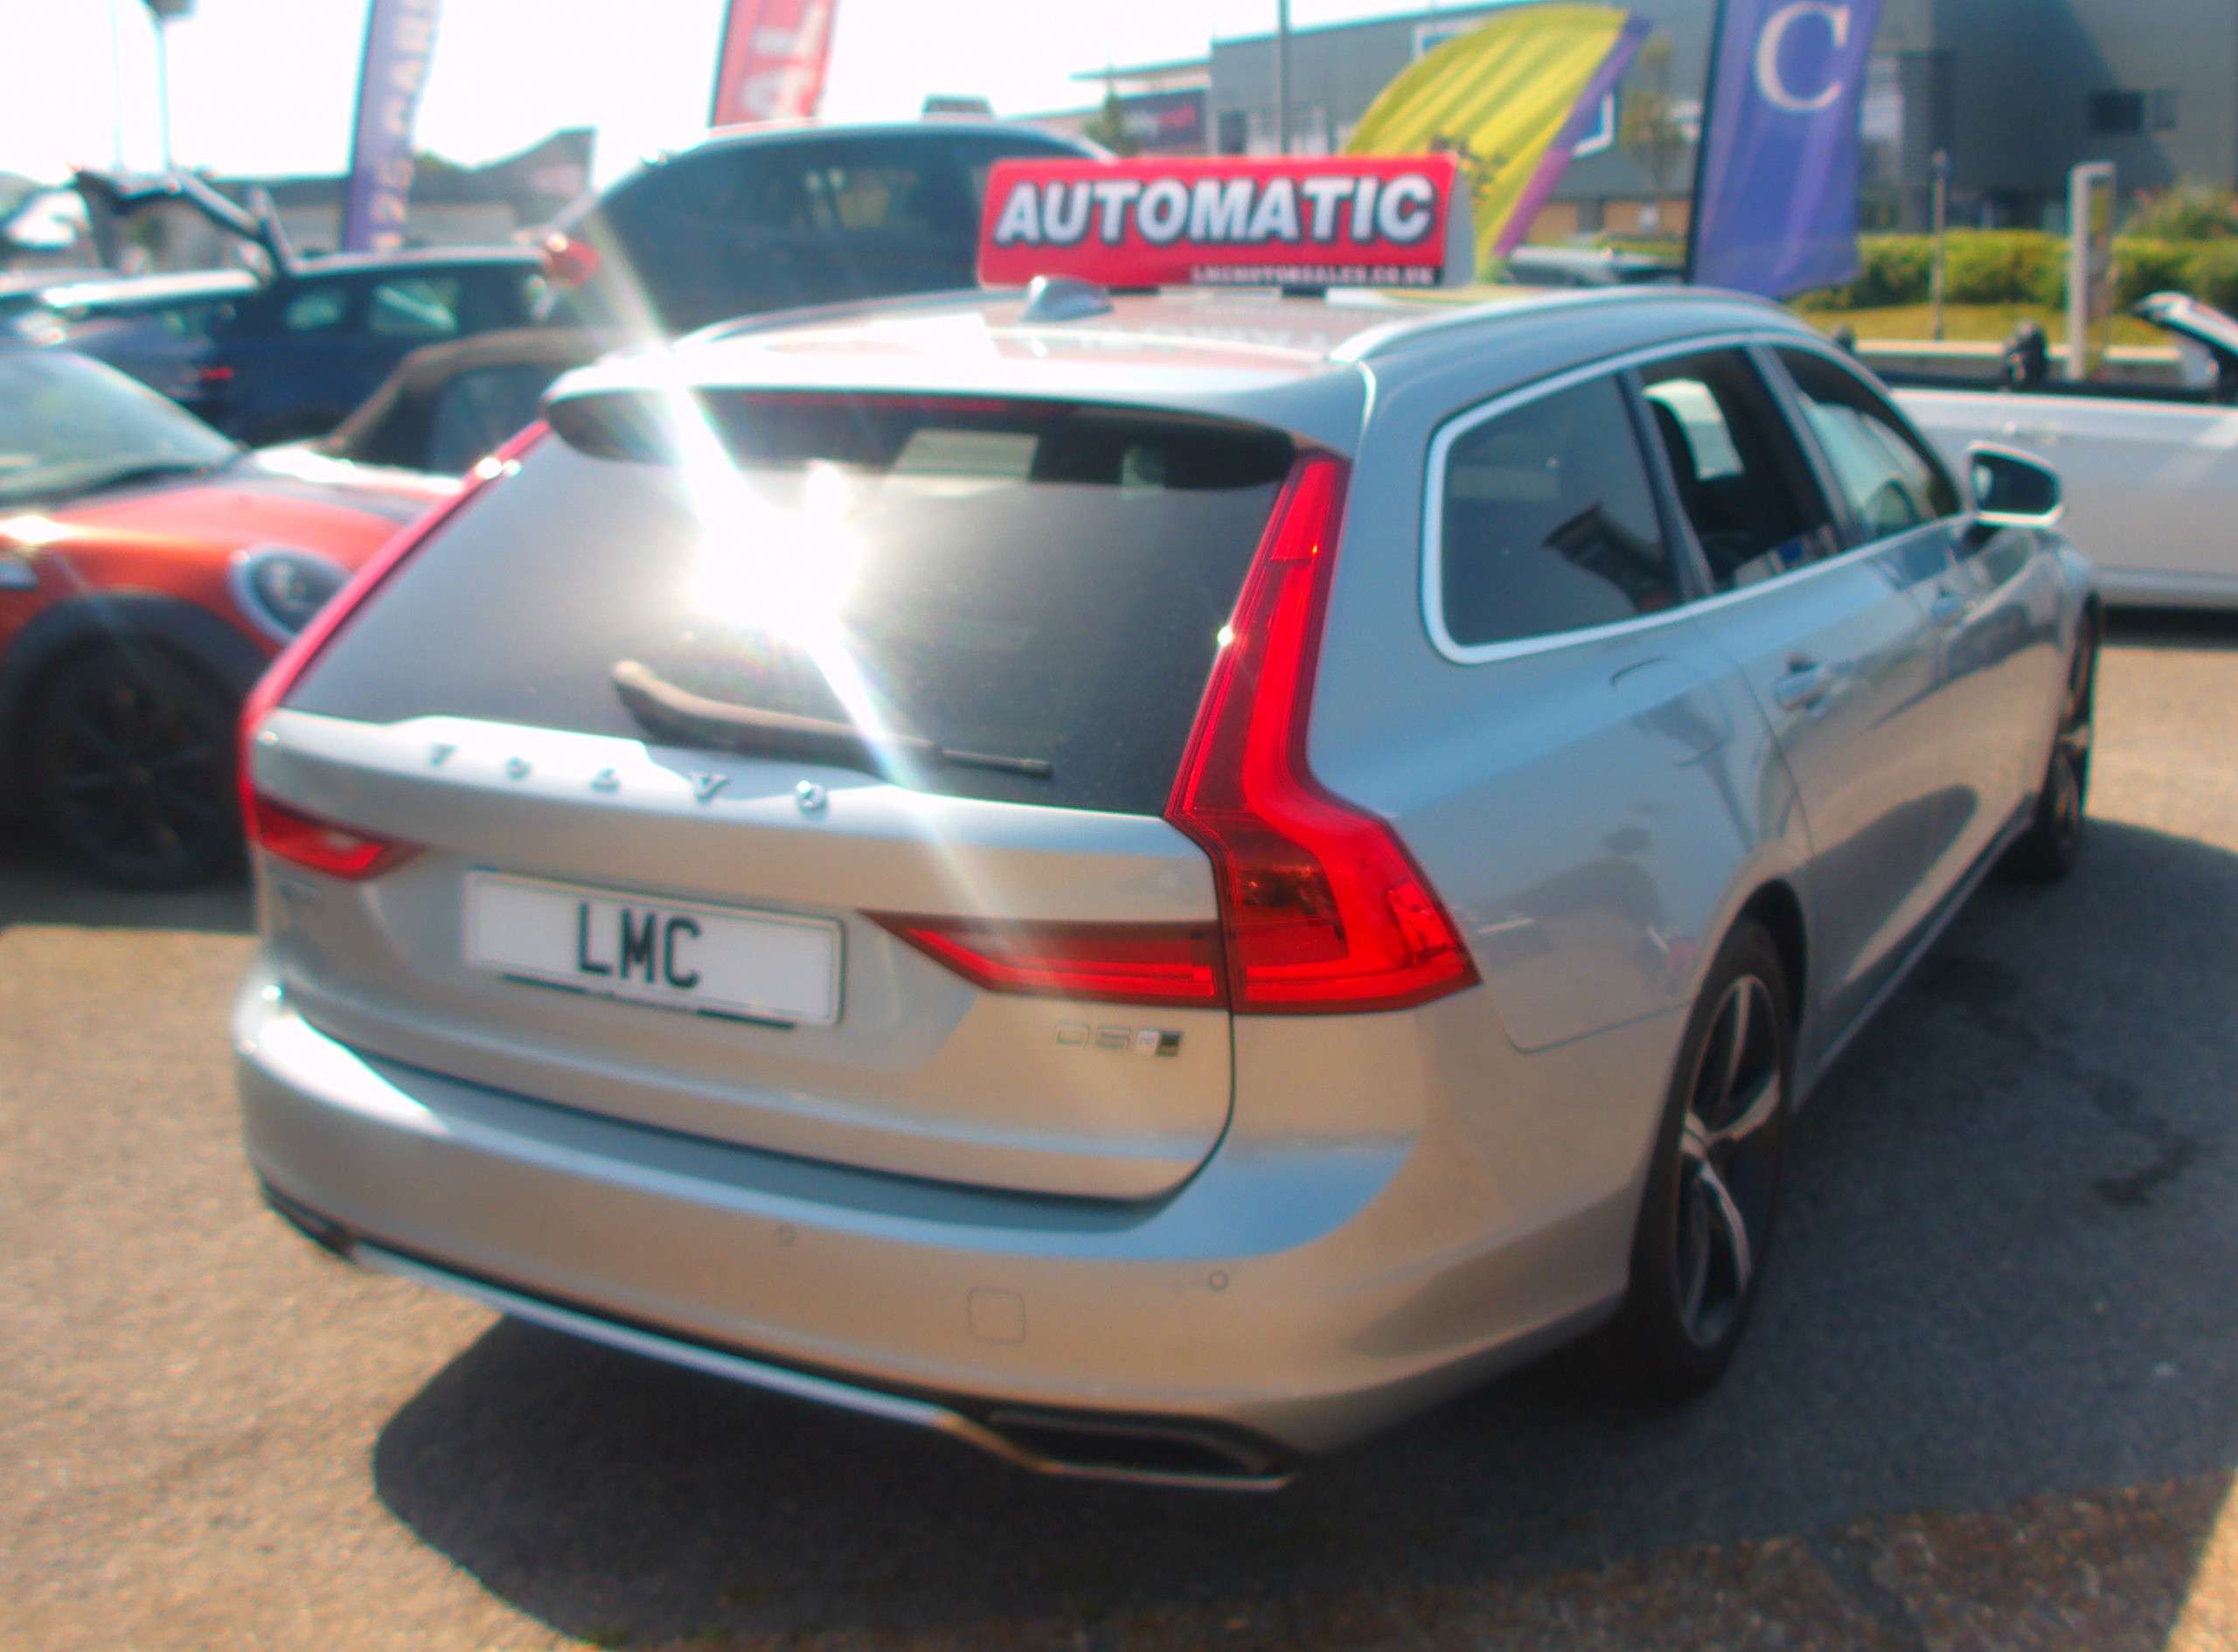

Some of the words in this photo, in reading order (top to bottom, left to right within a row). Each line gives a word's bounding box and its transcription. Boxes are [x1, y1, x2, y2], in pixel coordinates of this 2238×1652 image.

[1757, 2, 1850, 110] C
[994, 174, 1435, 245] AUTOMATIC
[578, 902, 701, 989] LMC
